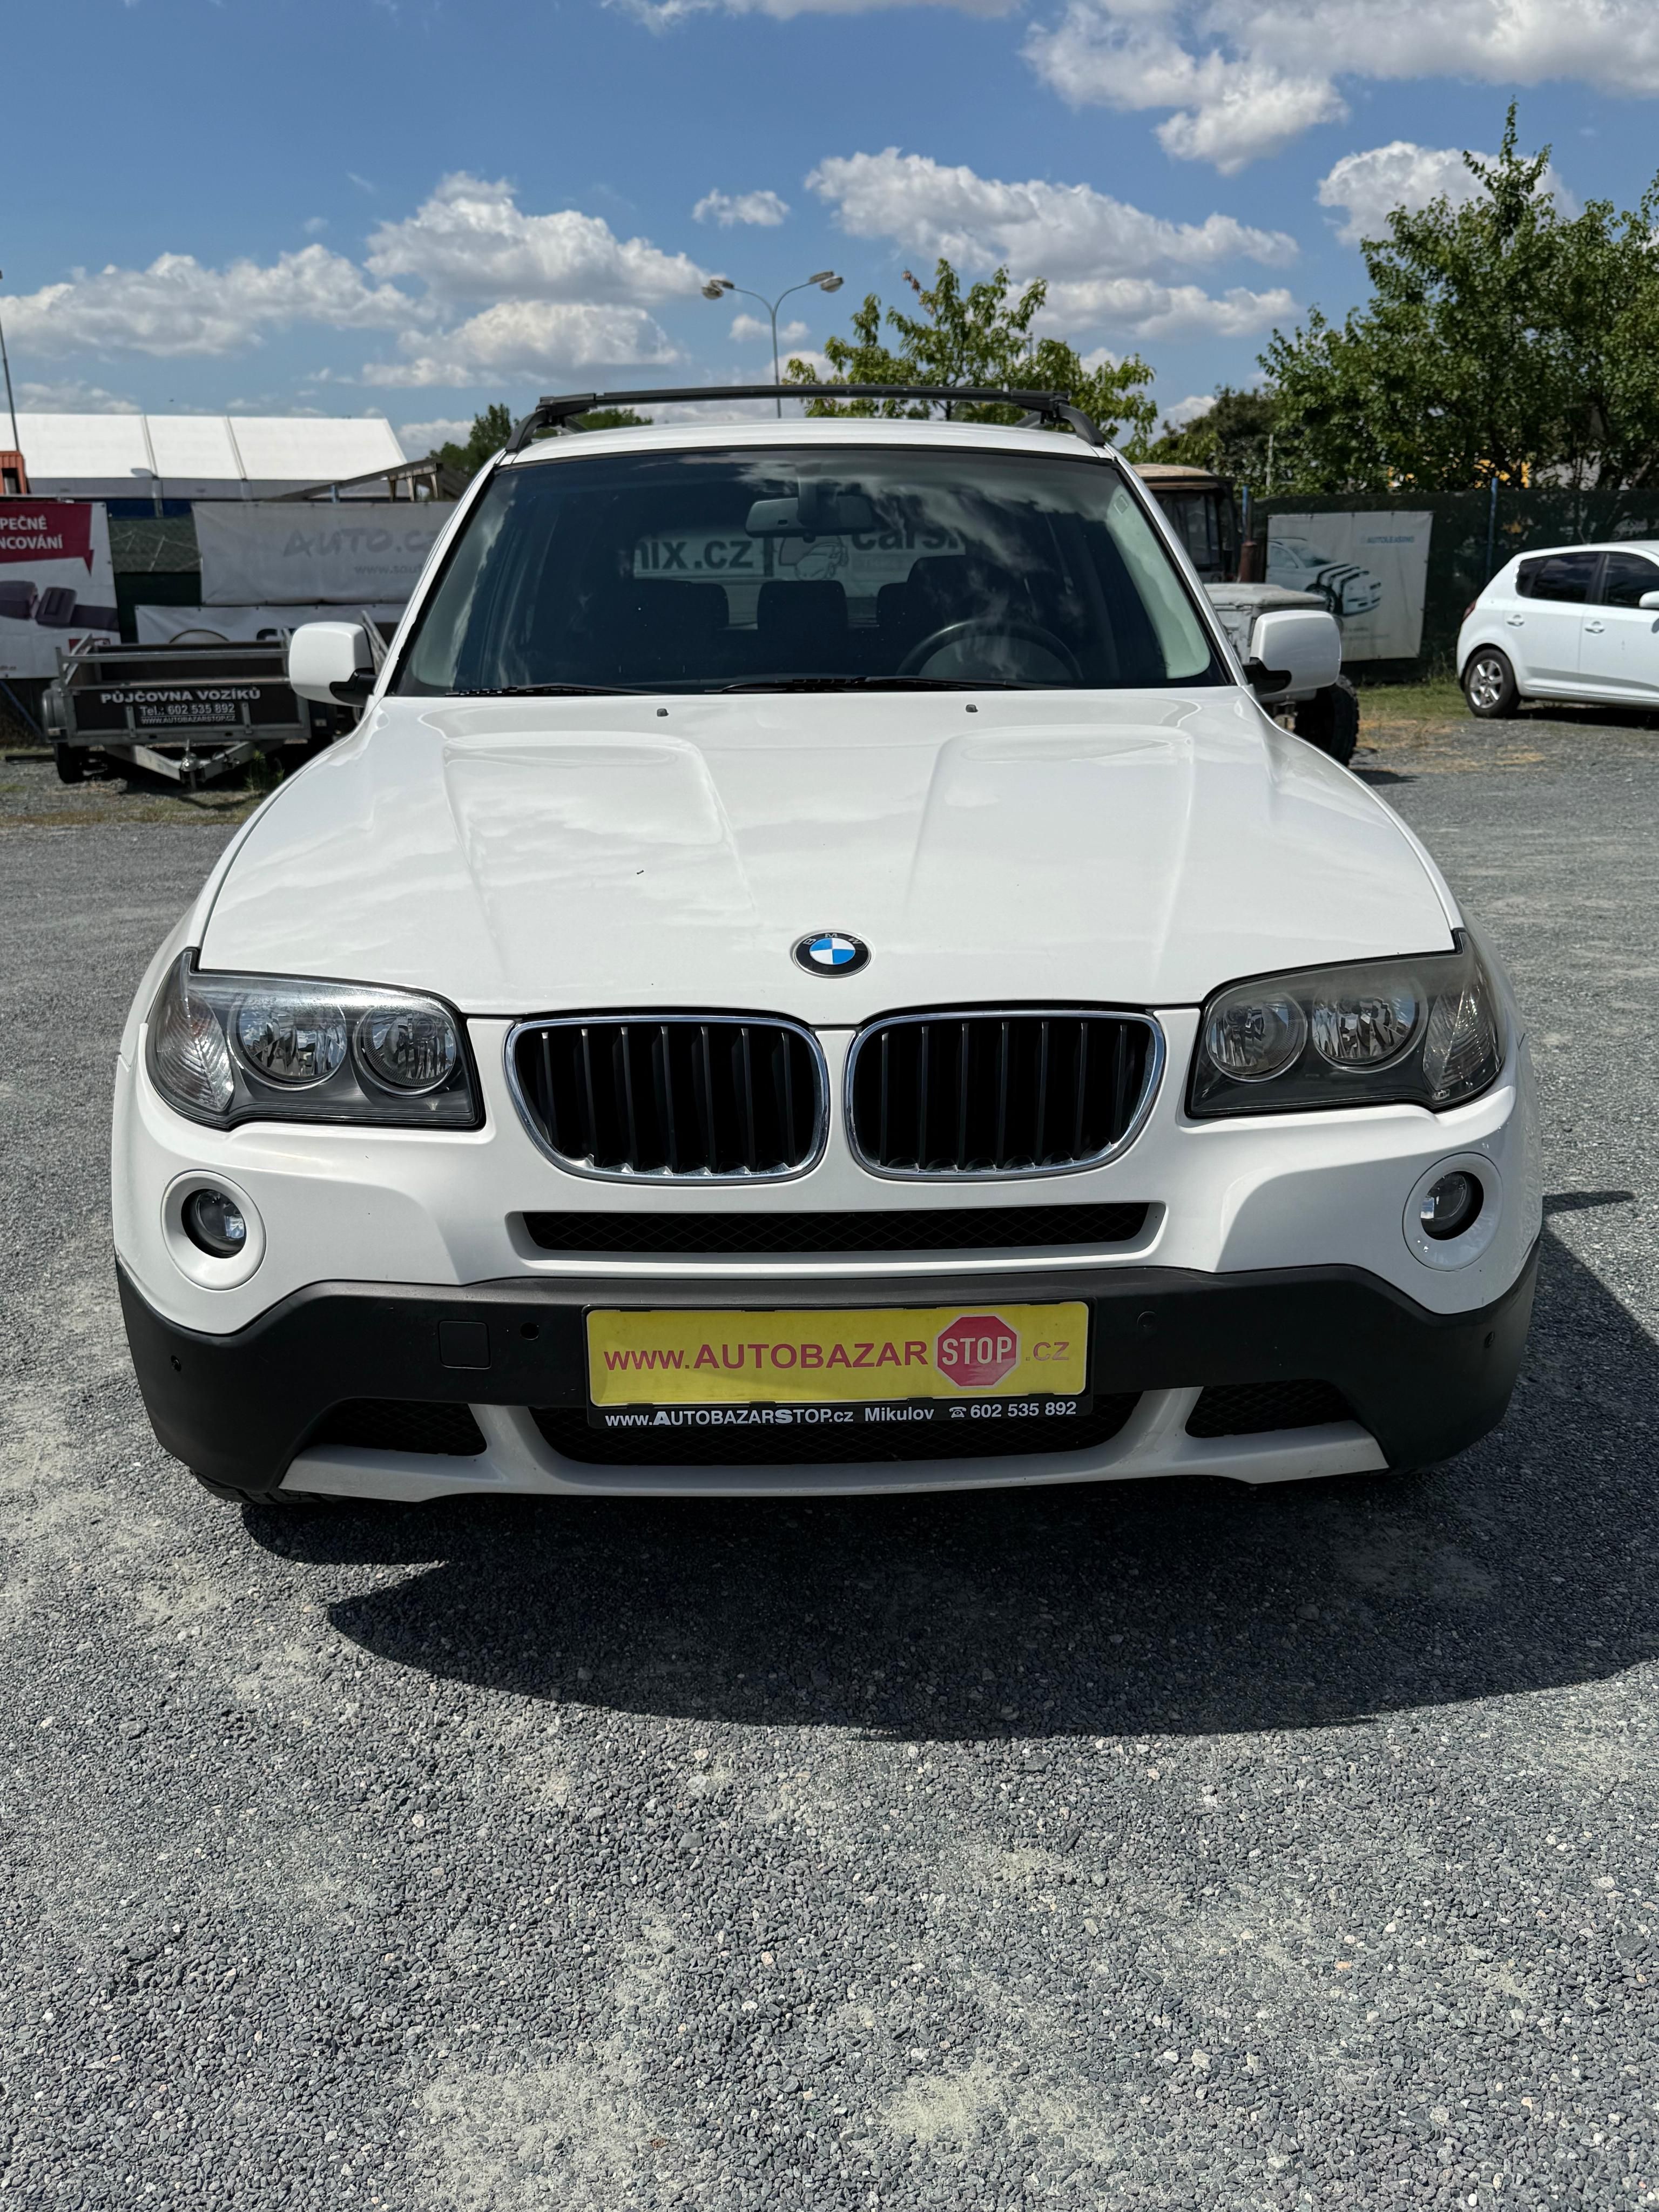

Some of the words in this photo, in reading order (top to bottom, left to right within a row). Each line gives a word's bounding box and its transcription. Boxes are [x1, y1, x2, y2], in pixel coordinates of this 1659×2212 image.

[100, 690, 193, 703] PŮJČOVNA
[197, 686, 261, 700] VOZÍKŮ
[140, 705, 164, 716] Tel.:
[167, 704, 188, 714] 602
[192, 704, 212, 714] 535
[215, 703, 235, 713] 892
[803, 933, 862, 945] BMW
[942, 1337, 1012, 1365] STOP
[605, 1409, 853, 1426] www.AUTOBAZARSTOP.cz
[865, 1407, 934, 1421] Mikulov
[970, 1404, 1002, 1418] 602
[1008, 1403, 1039, 1417] 535
[1045, 1401, 1076, 1415] 892
